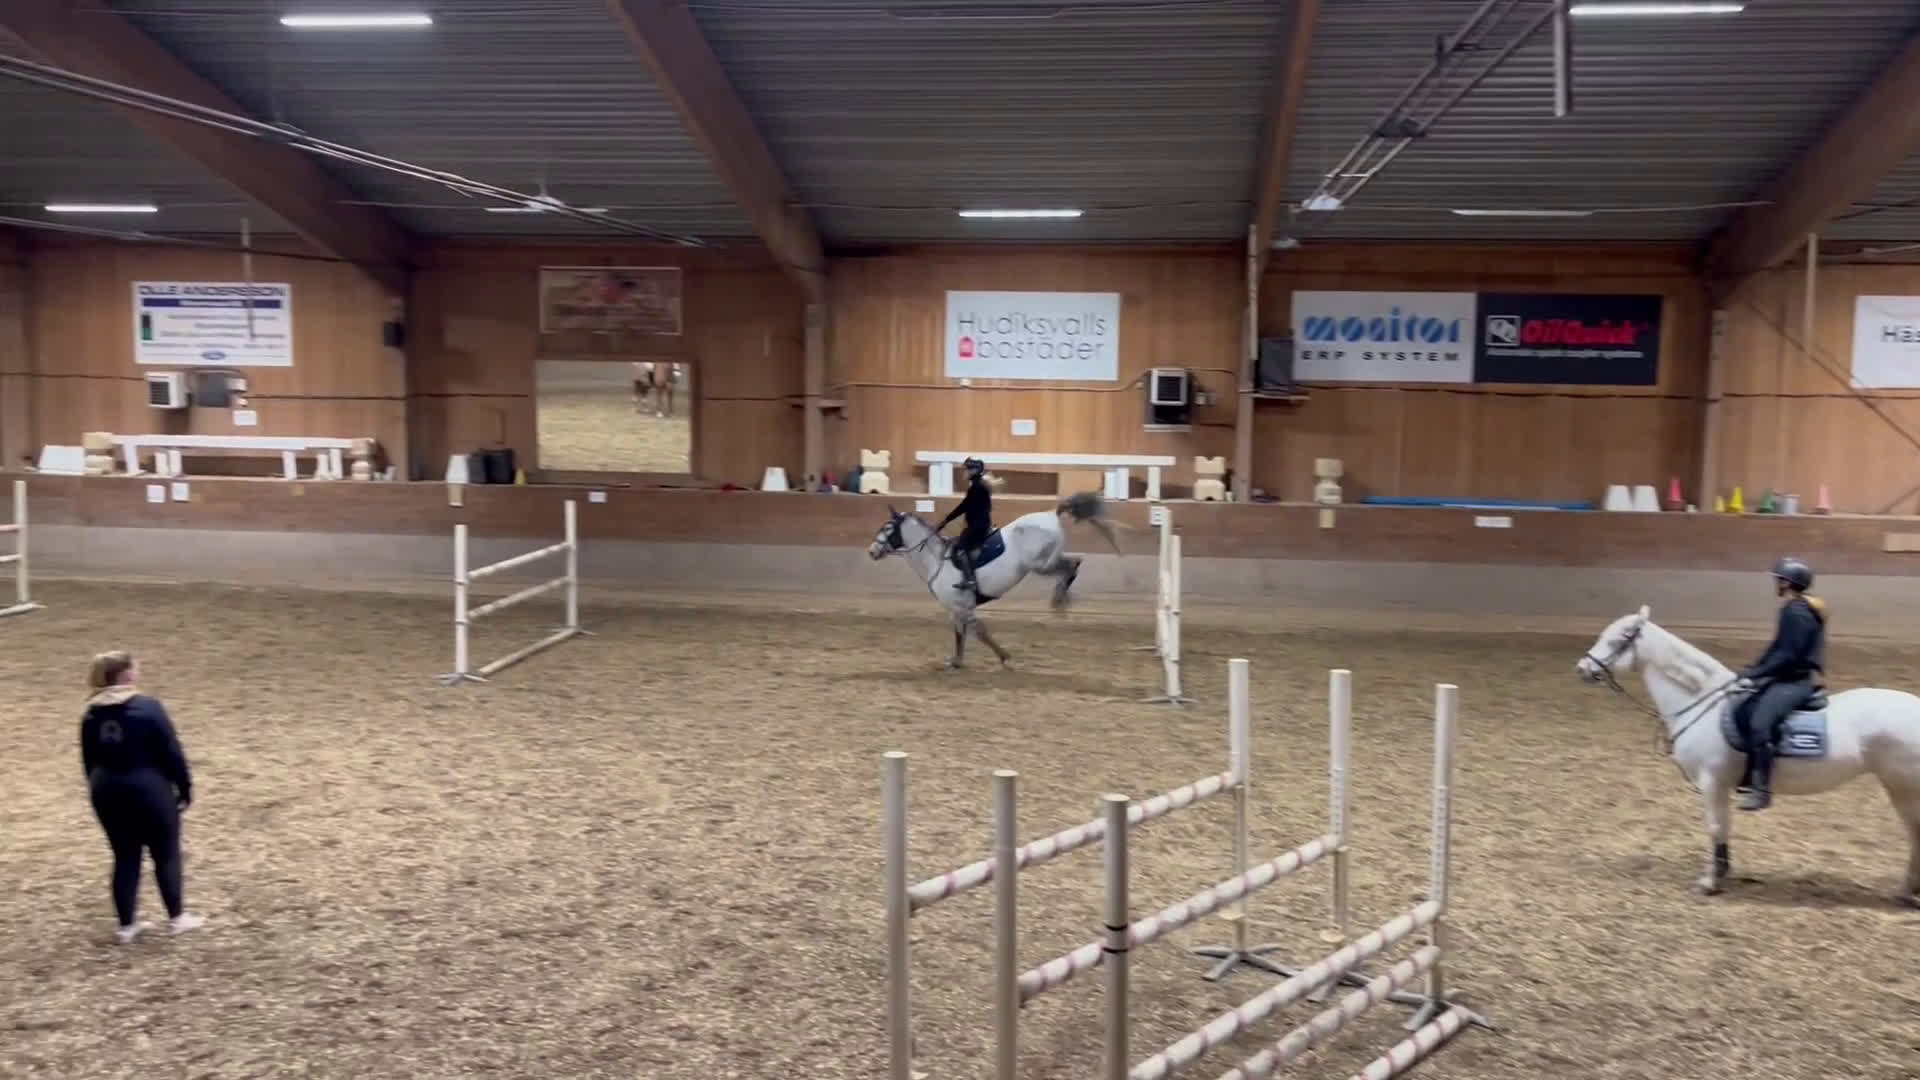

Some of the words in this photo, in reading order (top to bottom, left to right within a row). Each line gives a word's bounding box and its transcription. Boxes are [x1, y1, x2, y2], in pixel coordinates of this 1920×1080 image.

[958, 311, 1106, 336] Hudiksvalls
[1303, 306, 1461, 344] monitor
[1301, 350, 1346, 361] ERP
[1362, 351, 1460, 362] SYSTEM
